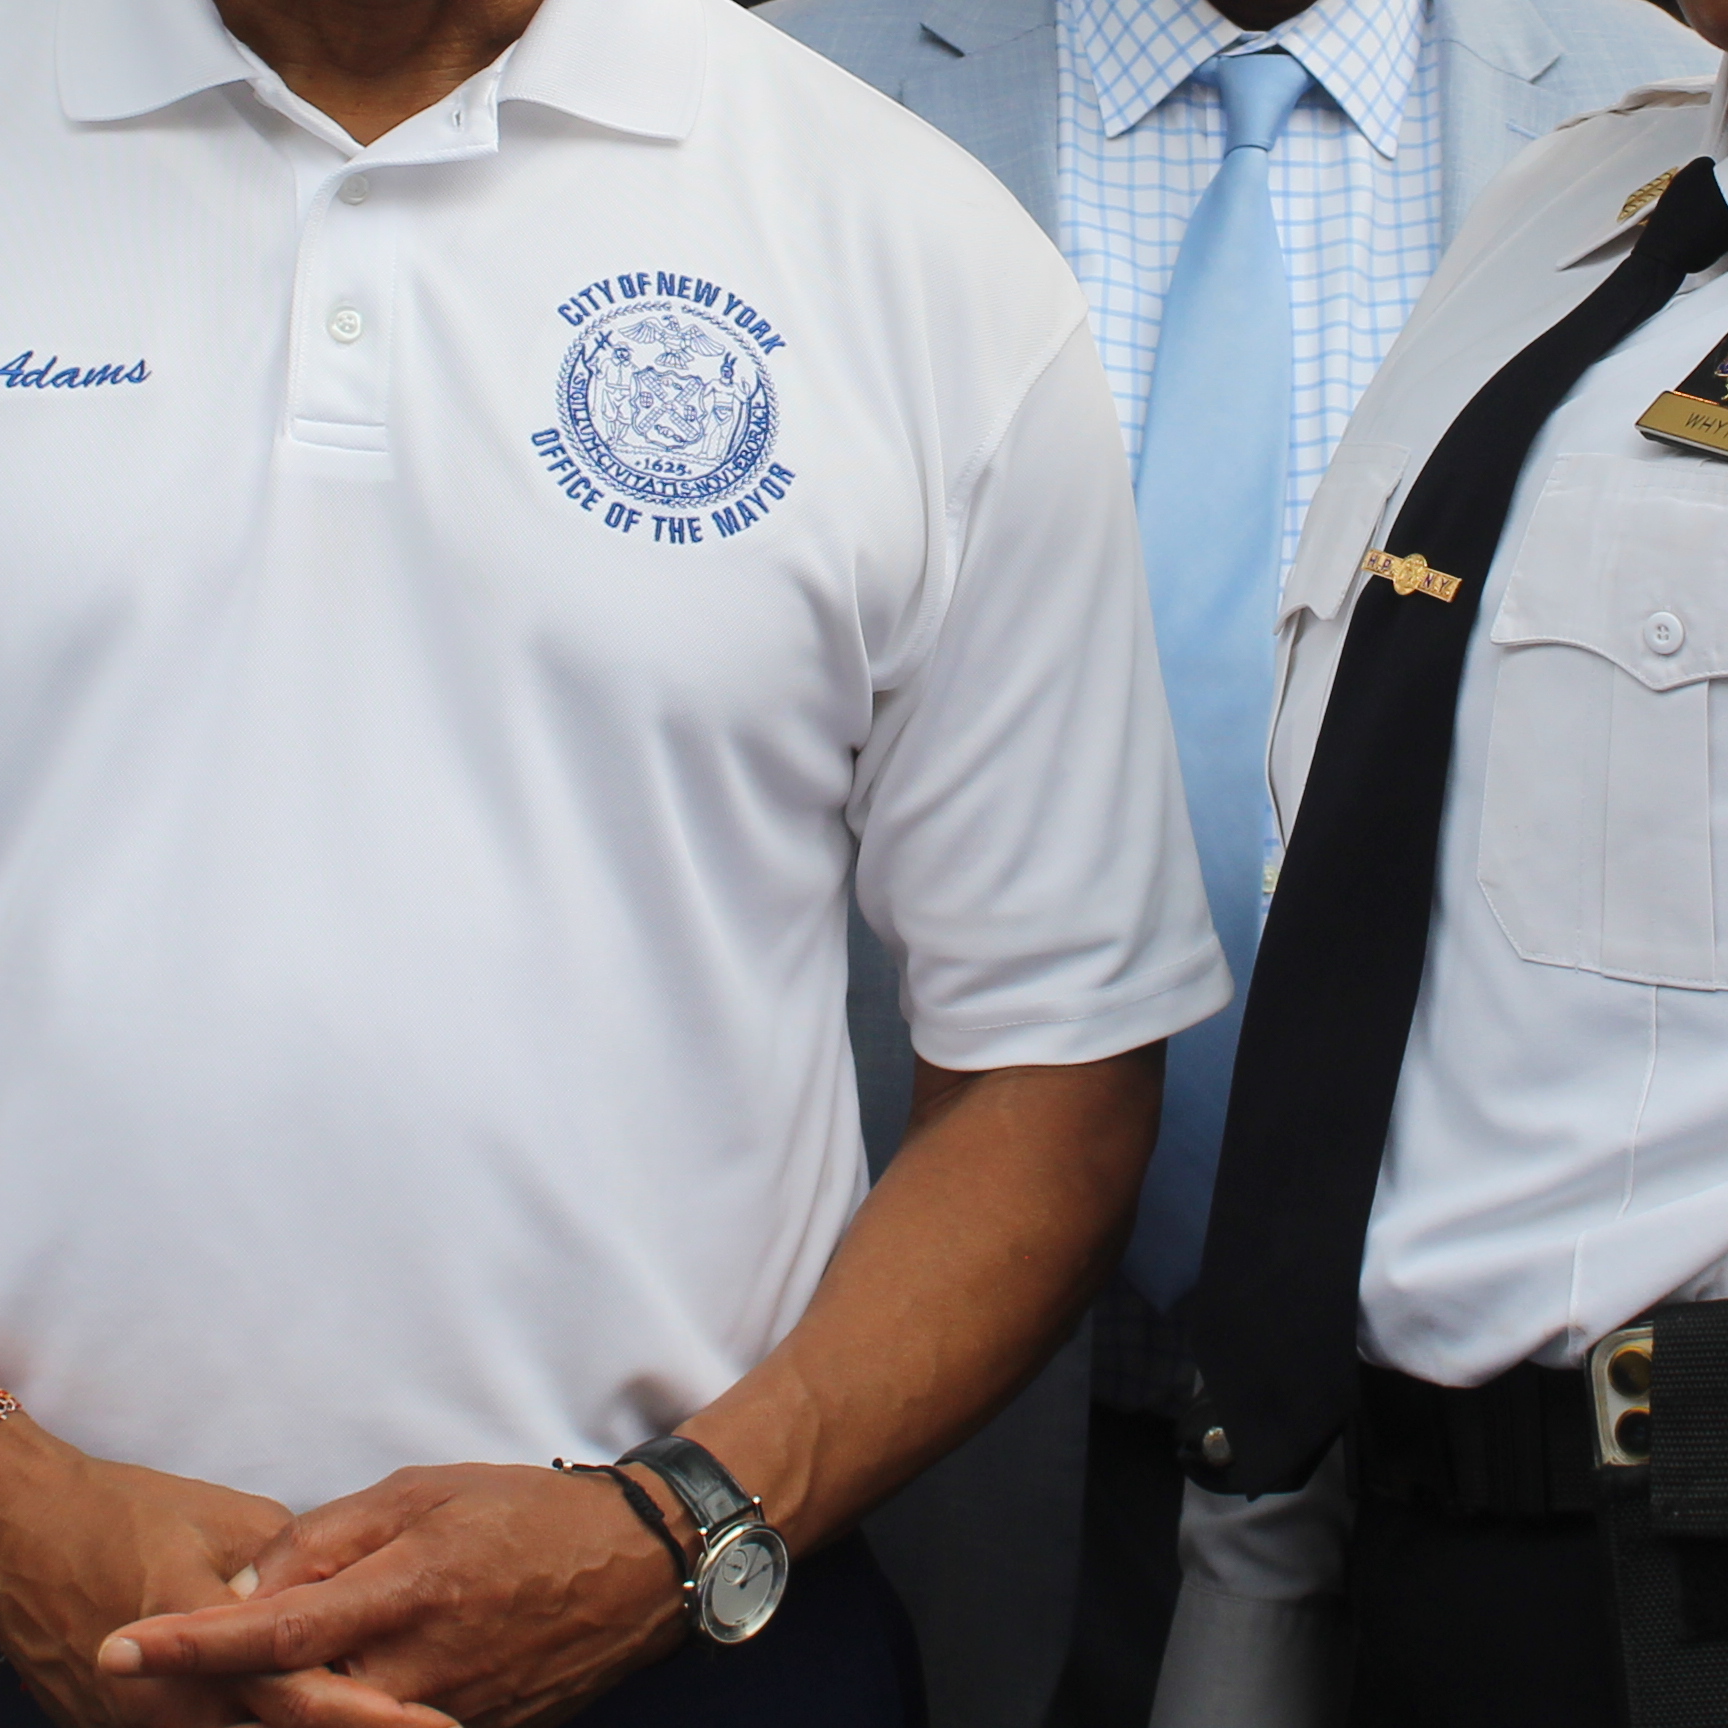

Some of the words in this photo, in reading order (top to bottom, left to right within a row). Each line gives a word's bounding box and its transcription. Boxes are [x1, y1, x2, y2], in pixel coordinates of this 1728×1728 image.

[557, 278, 616, 327] CITY
[618, 272, 652, 300] OF
[656, 270, 722, 308] NEW
[722, 291, 788, 356] YORK
[531, 427, 606, 512] OFFICE
[604, 501, 644, 533] OF
[652, 514, 704, 545] THE
[711, 461, 796, 538] MAYOR
